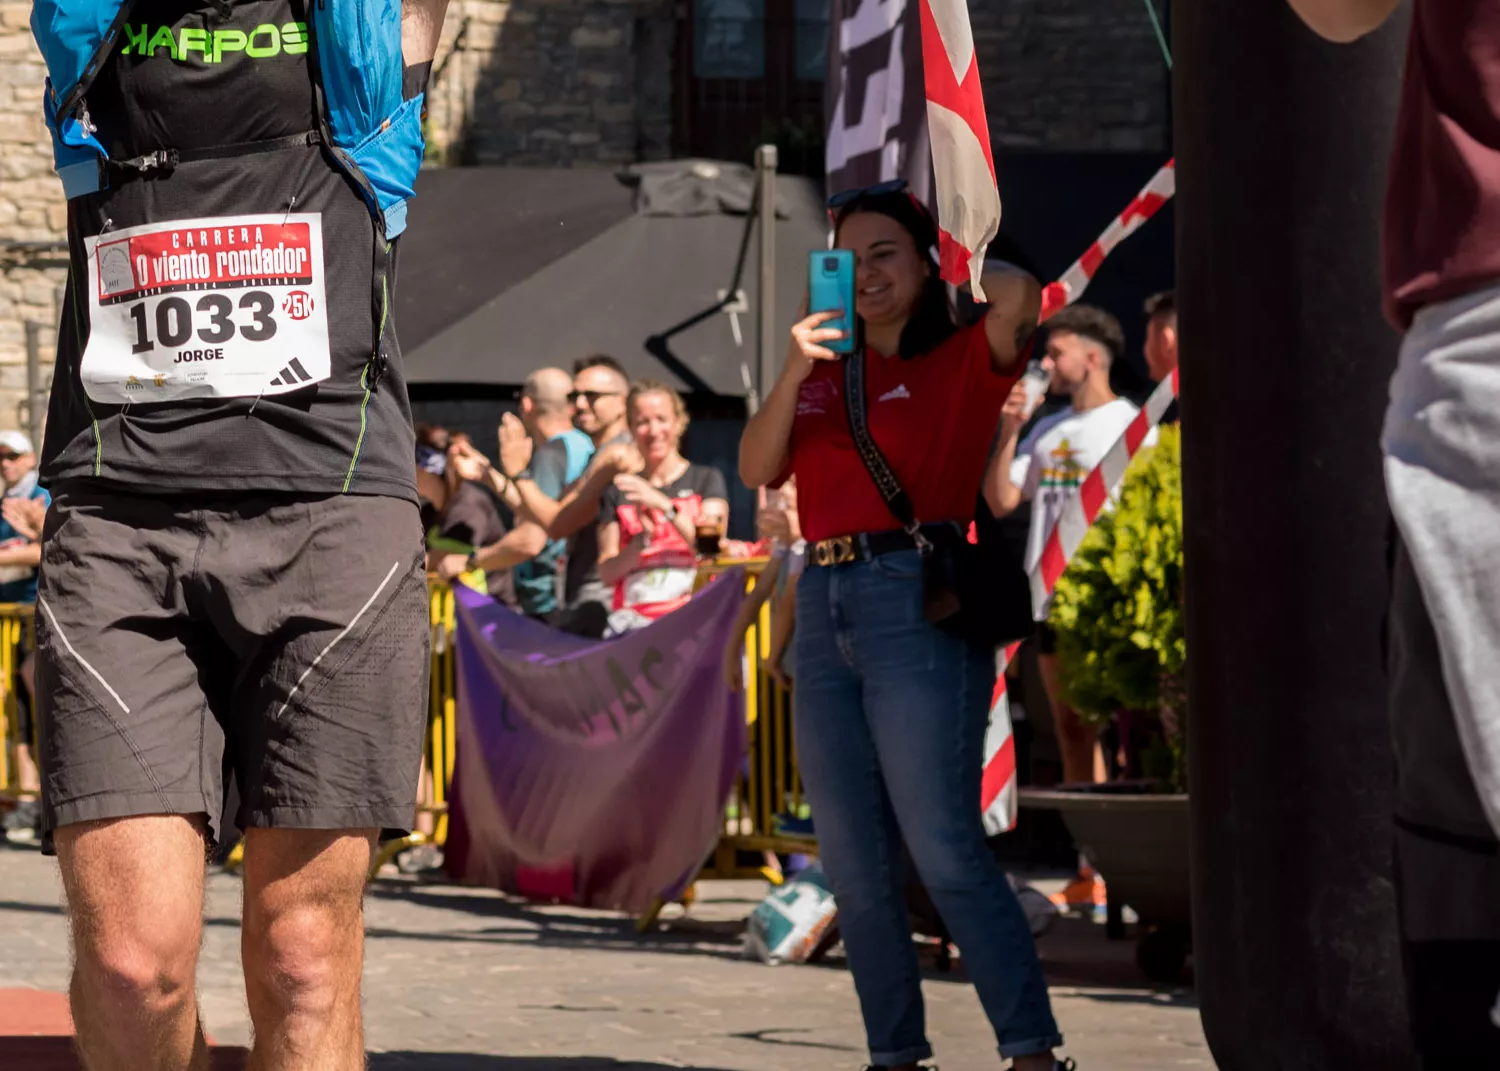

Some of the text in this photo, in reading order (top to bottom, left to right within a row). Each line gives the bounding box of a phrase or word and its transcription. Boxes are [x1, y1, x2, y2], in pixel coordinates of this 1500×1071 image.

[121, 22, 309, 64] KARPOS
[172, 226, 263, 249] CARRERA
[136, 254, 148, 286] O
[153, 251, 210, 283] viento
[216, 243, 307, 278] rondador
[186, 281, 217, 291] 2024
[282, 294, 314, 318] 25K
[130, 291, 278, 355] 1033
[173, 348, 224, 364] JORGE
